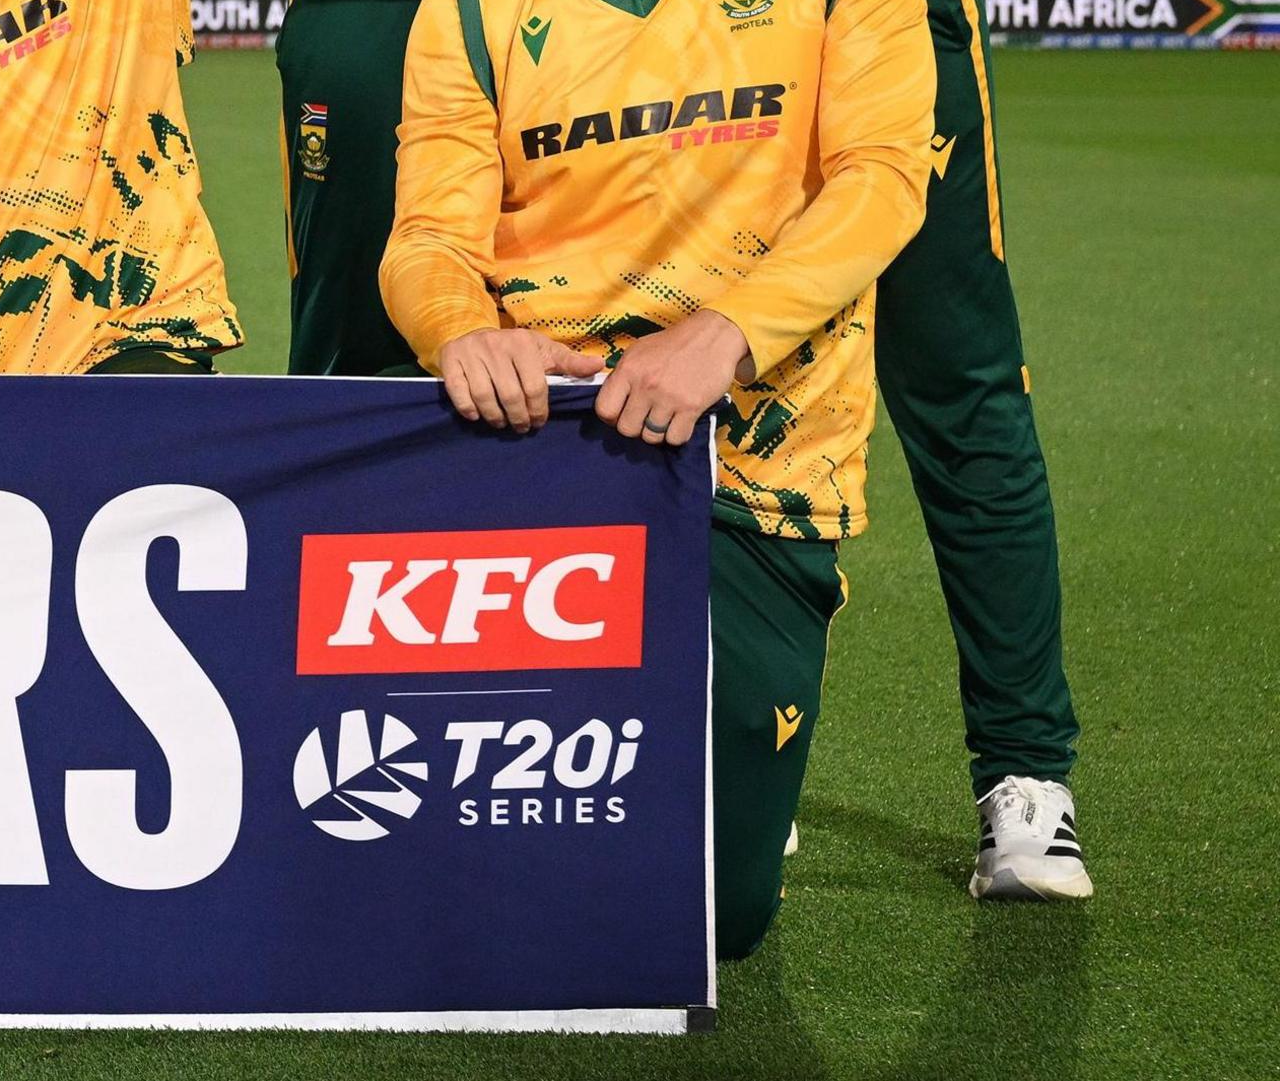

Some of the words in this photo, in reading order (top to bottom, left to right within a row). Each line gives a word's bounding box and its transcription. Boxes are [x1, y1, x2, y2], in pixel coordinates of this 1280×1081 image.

[730, 18, 774, 33] PROTEAS
[520, 83, 786, 161] RADAR
[668, 120, 780, 151] TYRES
[326, 553, 616, 647] KFC
[444, 718, 644, 790] T20i
[459, 796, 626, 826] SERIES
